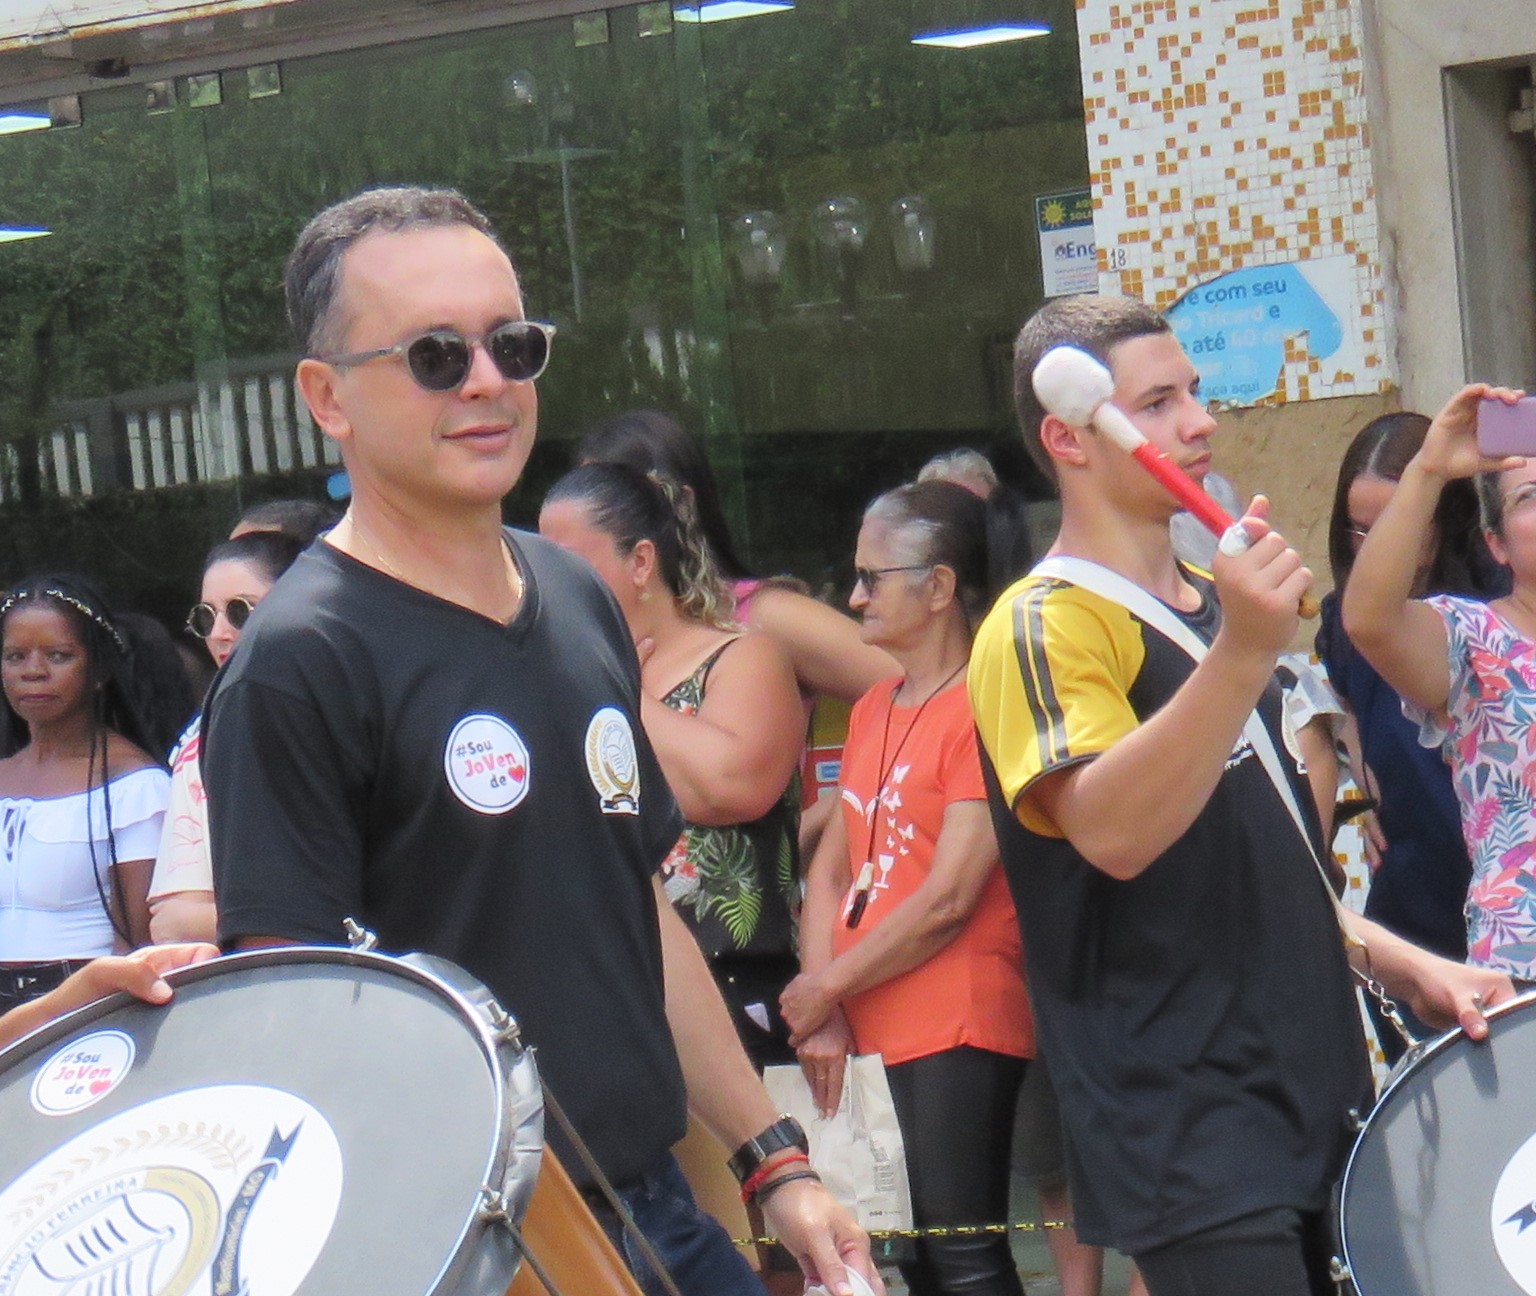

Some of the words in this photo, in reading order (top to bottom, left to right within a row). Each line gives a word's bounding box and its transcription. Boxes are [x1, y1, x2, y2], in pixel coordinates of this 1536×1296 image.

[1204, 283, 1247, 305] com
[1251, 277, 1287, 297] seu
[1268, 304, 1281, 319] e
[1192, 330, 1226, 355] até
[455, 739, 494, 758] #Sou
[489, 773, 508, 789] de
[64, 1081, 85, 1096] de
